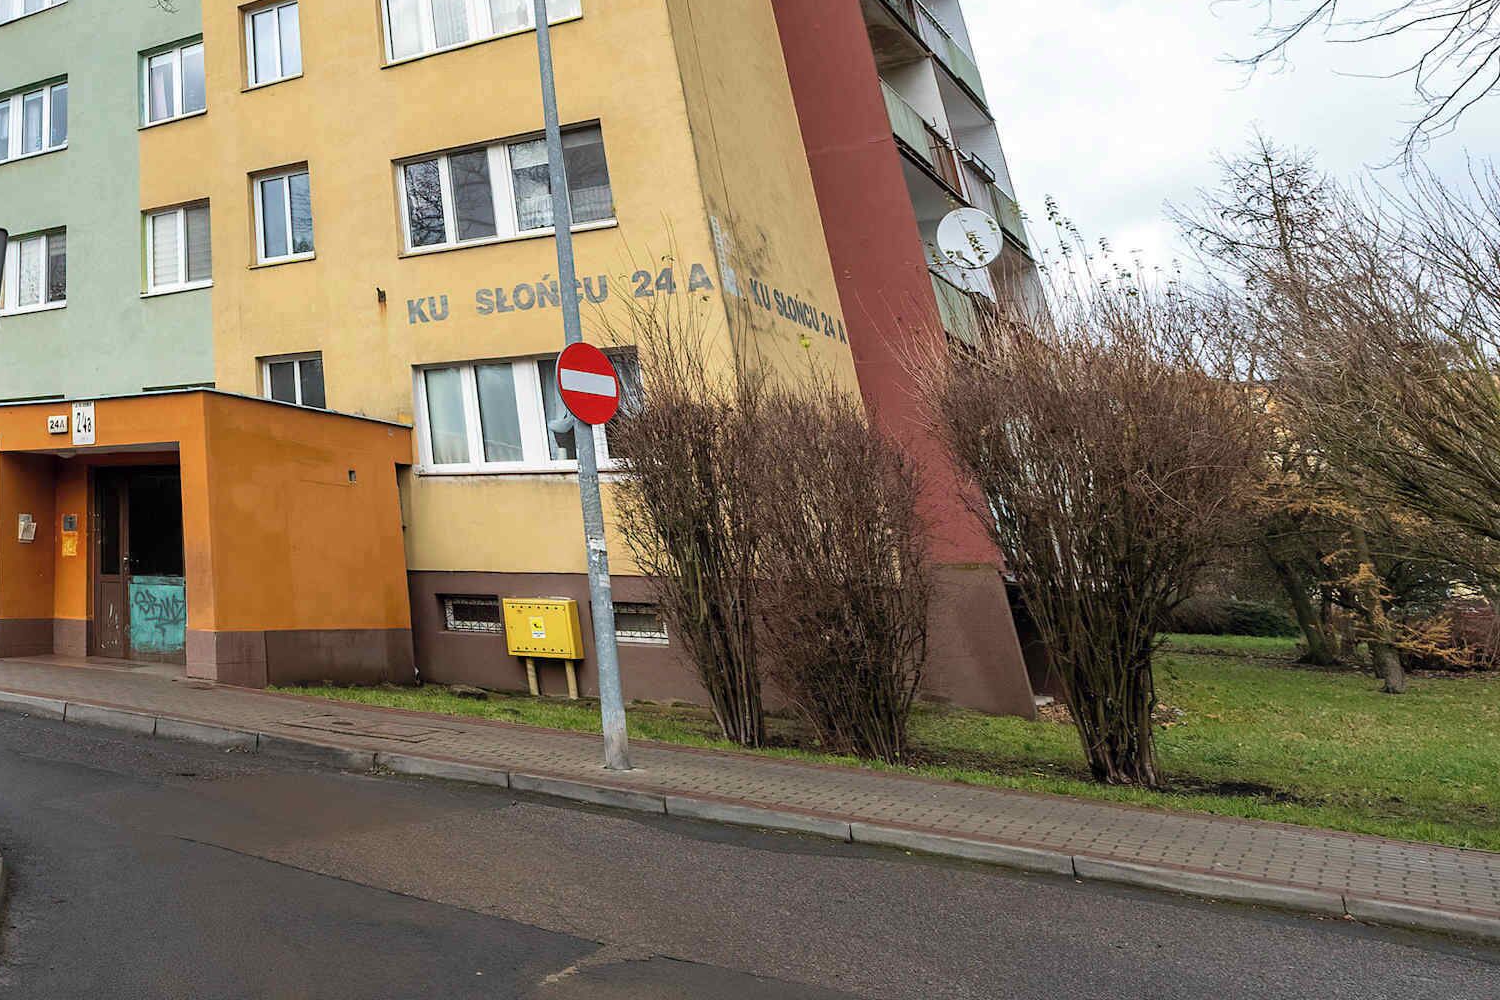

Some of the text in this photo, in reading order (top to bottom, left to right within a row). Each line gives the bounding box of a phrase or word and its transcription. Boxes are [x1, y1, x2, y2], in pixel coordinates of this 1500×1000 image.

[407, 295, 449, 325] KU
[631, 267, 676, 298] 24
[688, 263, 714, 293] A
[749, 278, 771, 311] KU
[773, 289, 820, 333] SŁOŃCU
[821, 312, 836, 339] 24
